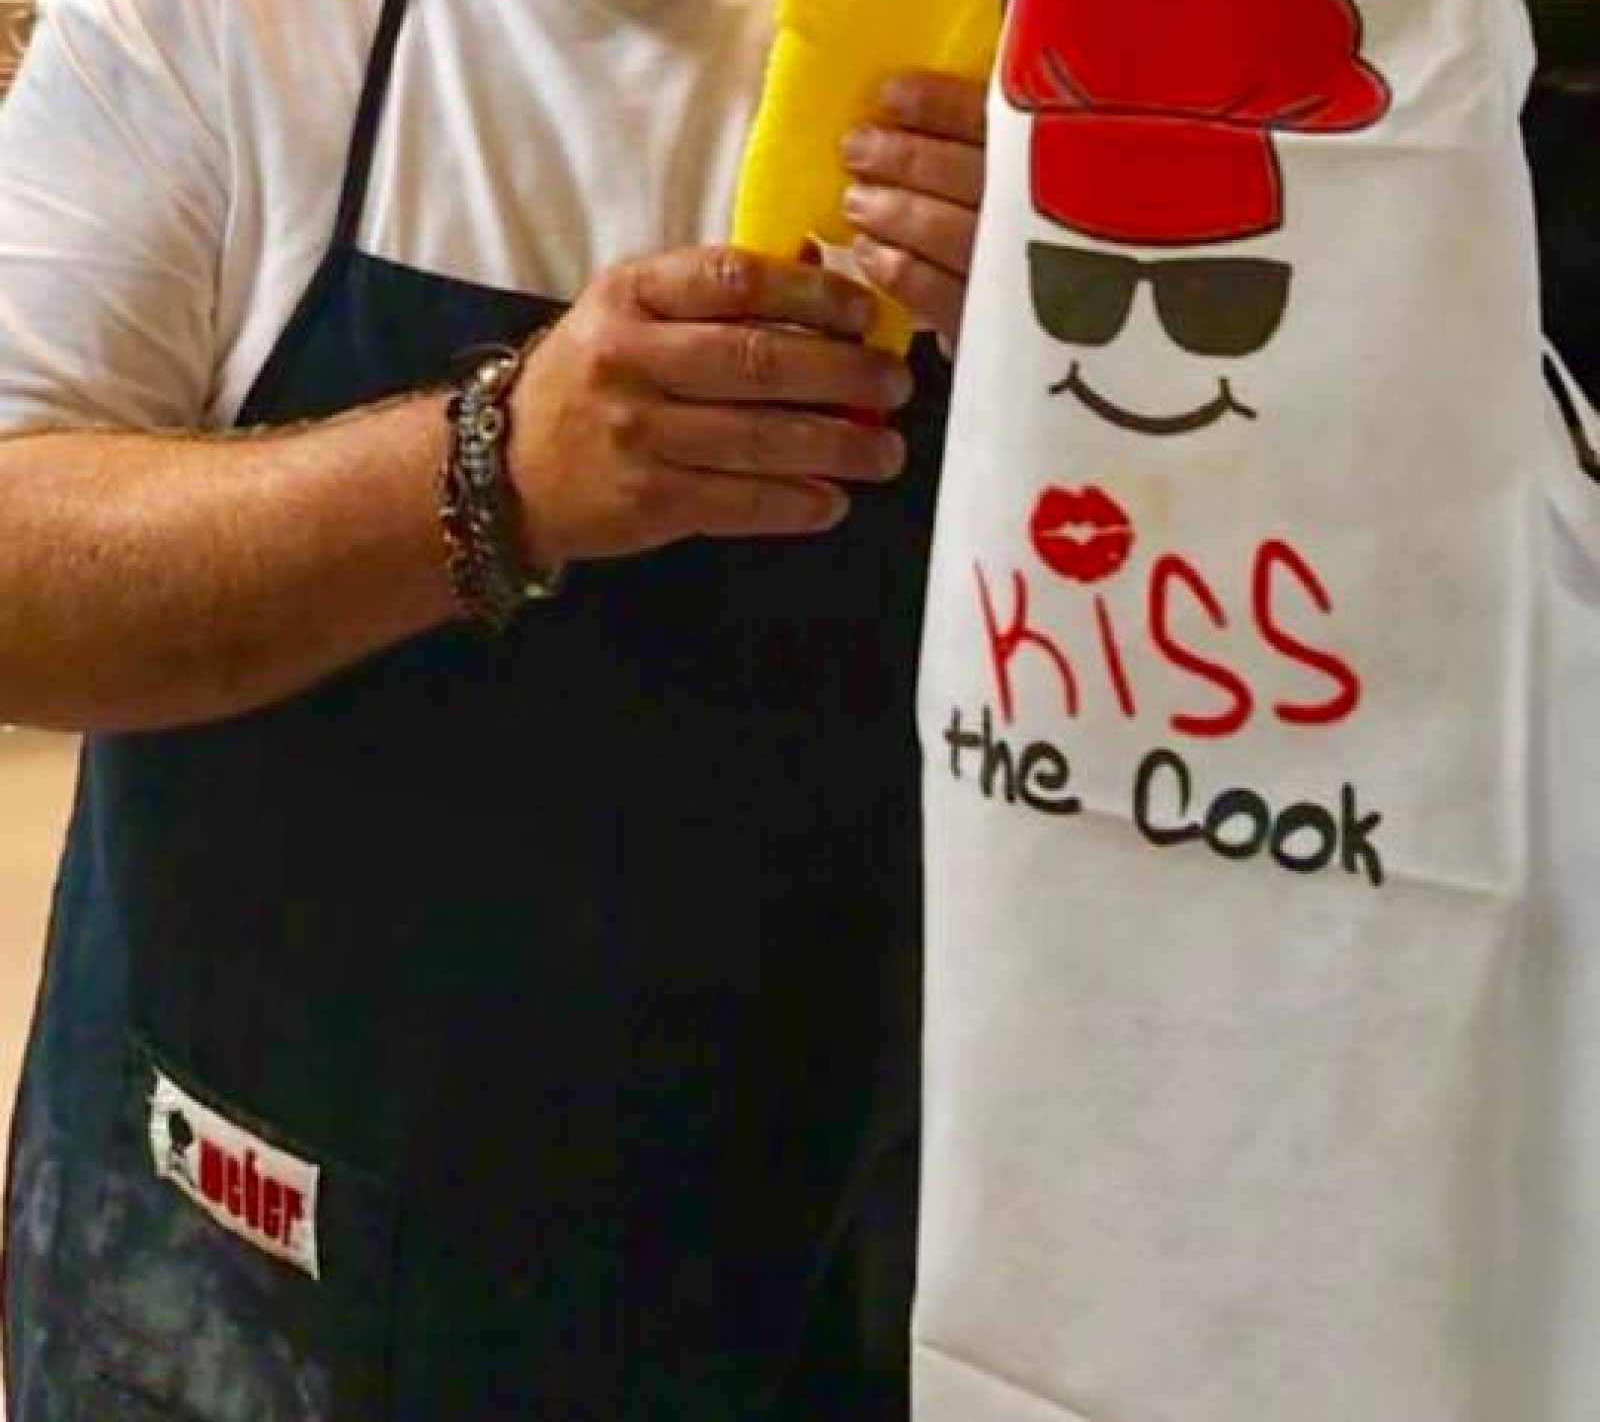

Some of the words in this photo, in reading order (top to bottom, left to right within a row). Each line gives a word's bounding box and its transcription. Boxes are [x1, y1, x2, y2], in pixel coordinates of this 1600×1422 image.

[943, 704, 1082, 815] the
[1133, 748, 1385, 887] Cook
[199, 1136, 306, 1247] weber
